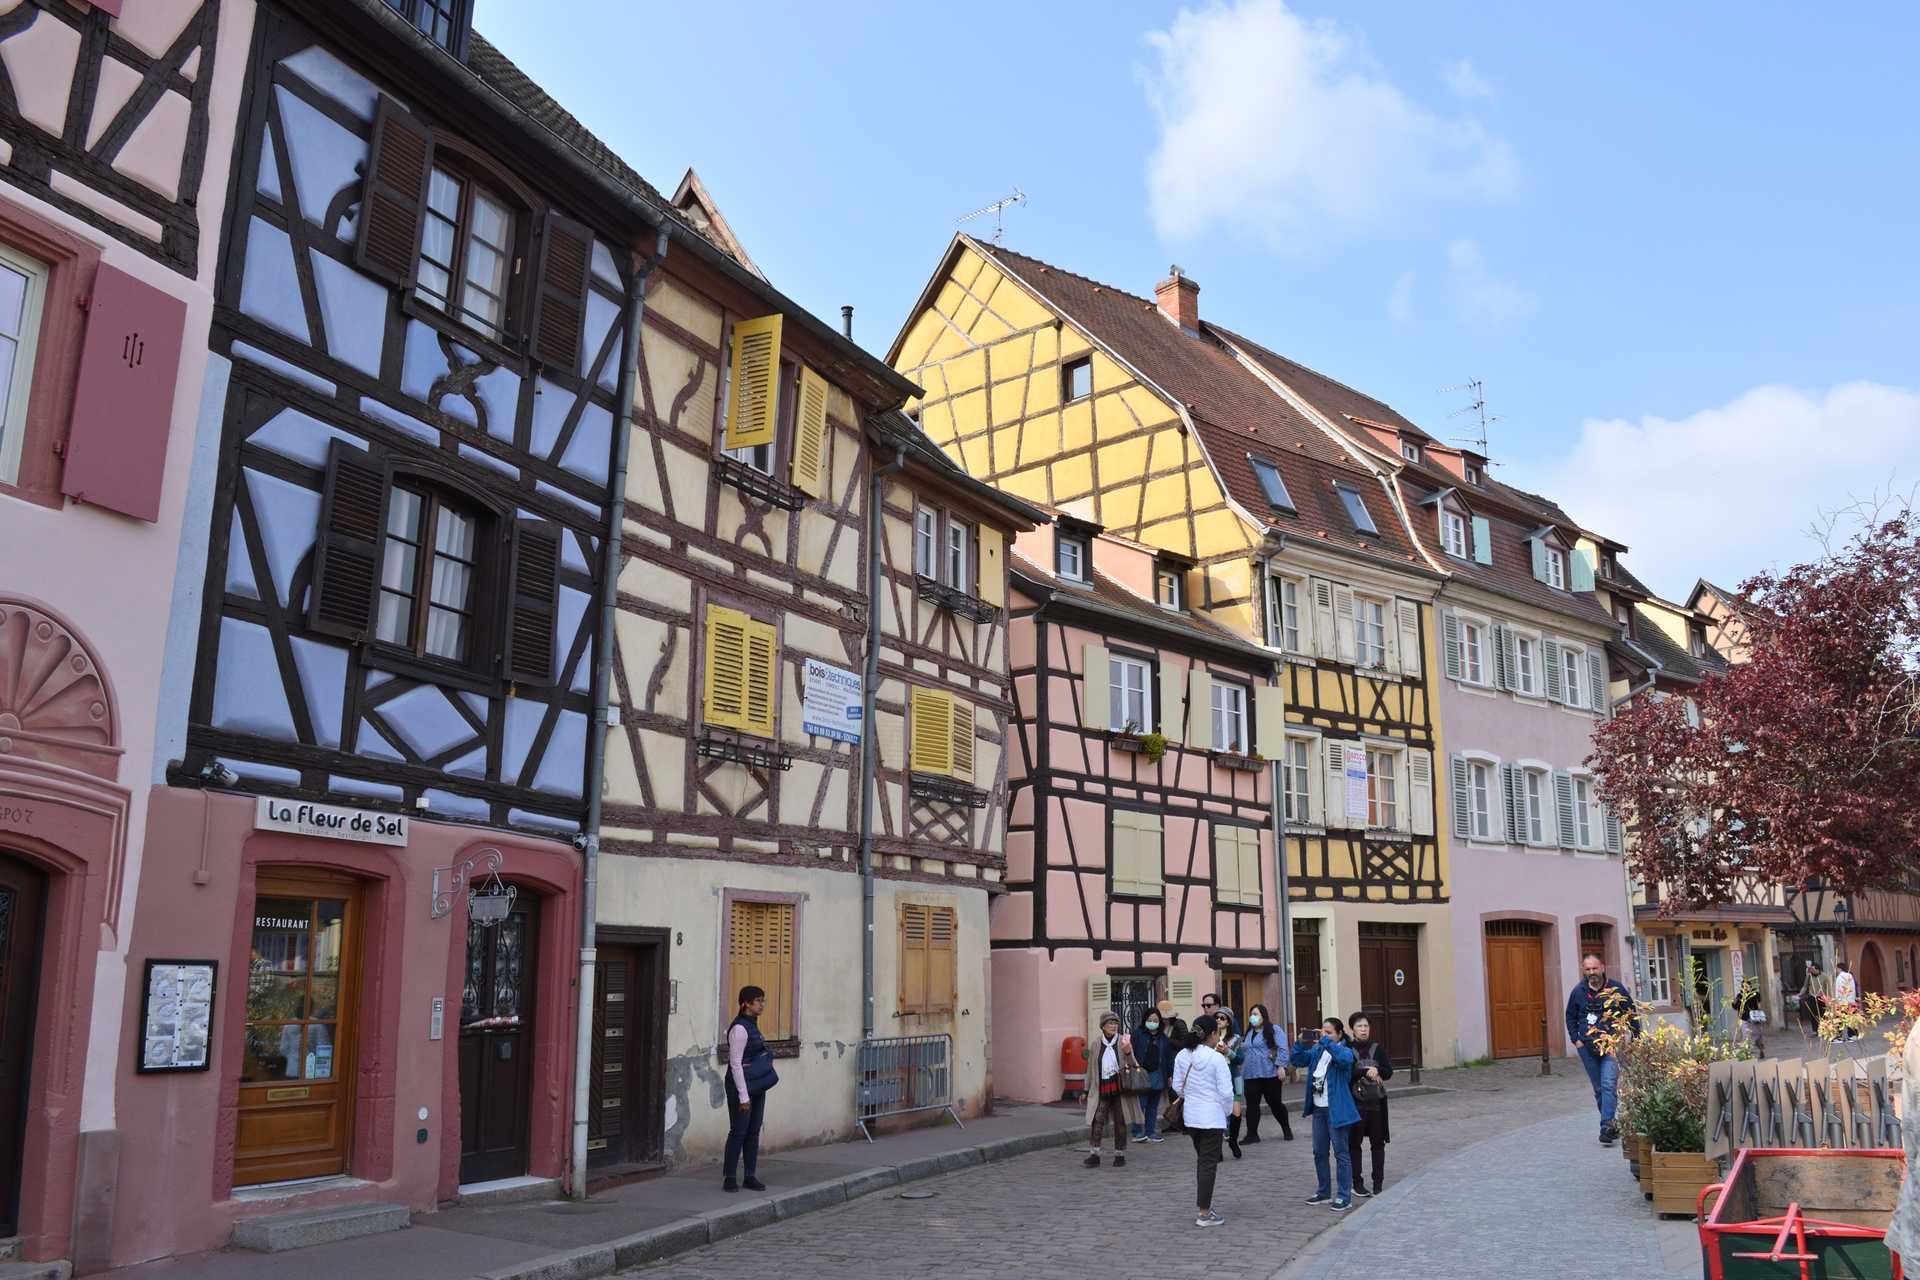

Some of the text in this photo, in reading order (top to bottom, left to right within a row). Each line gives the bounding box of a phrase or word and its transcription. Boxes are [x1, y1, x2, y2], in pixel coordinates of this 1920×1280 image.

[269, 800, 292, 822] La
[350, 812, 372, 832] de
[376, 815, 403, 836] Sel
[255, 917, 309, 929] RESTAURANT
[676, 931, 683, 946] 8
